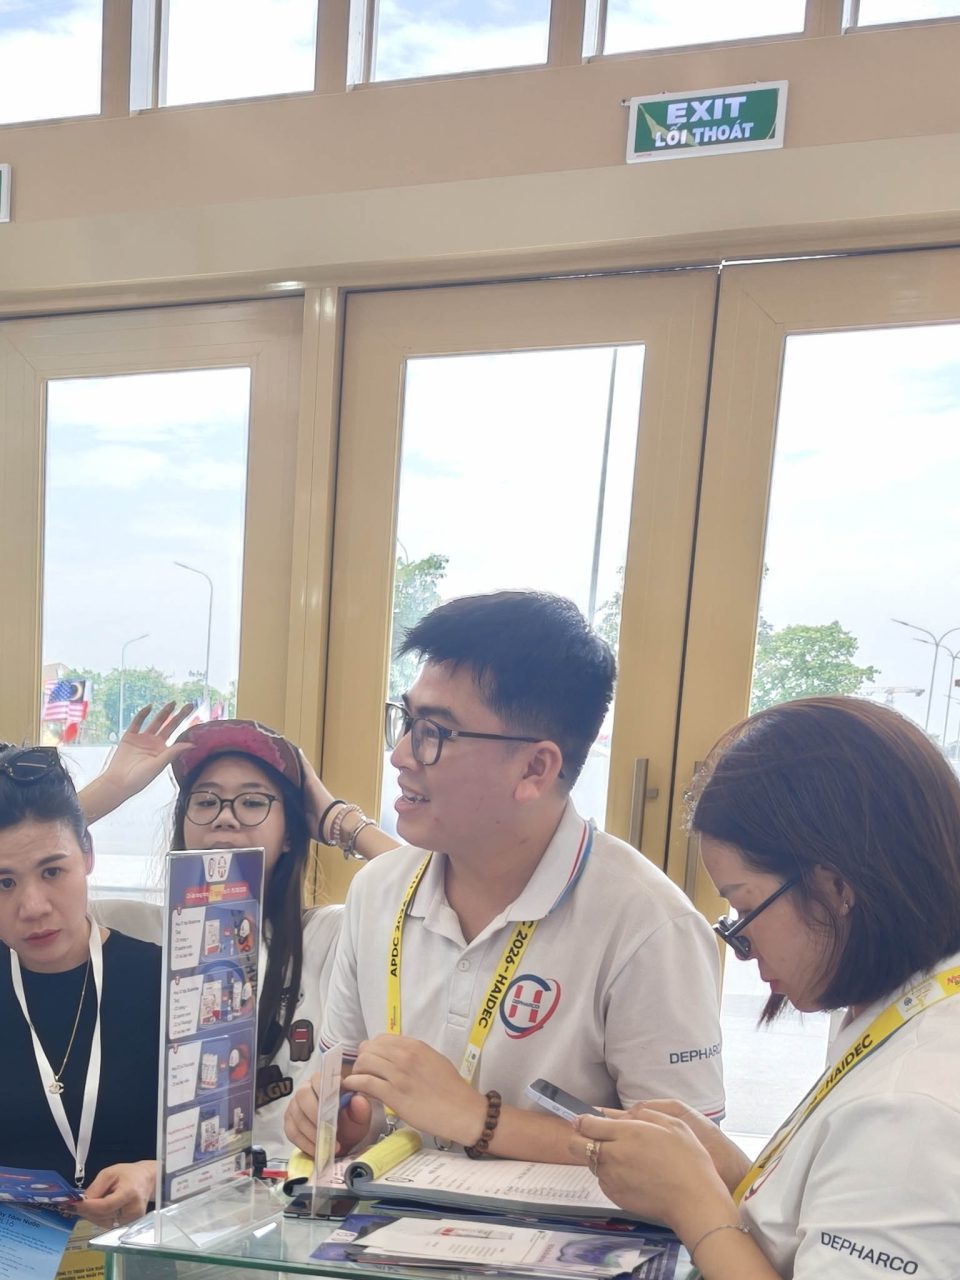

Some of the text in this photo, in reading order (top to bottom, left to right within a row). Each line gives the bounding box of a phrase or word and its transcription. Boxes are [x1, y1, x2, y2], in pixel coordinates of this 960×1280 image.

[666, 96, 746, 125] EXIT
[655, 120, 754, 147] LỐI THOÁT
[390, 936, 400, 977] APDC
[505, 930, 528, 965] 2026
[478, 973, 508, 1029] HAIDEC
[669, 1043, 720, 1064] DEPHAR
[825, 1034, 873, 1088] HAIDEC
[821, 1231, 918, 1275] DEPHARCO
